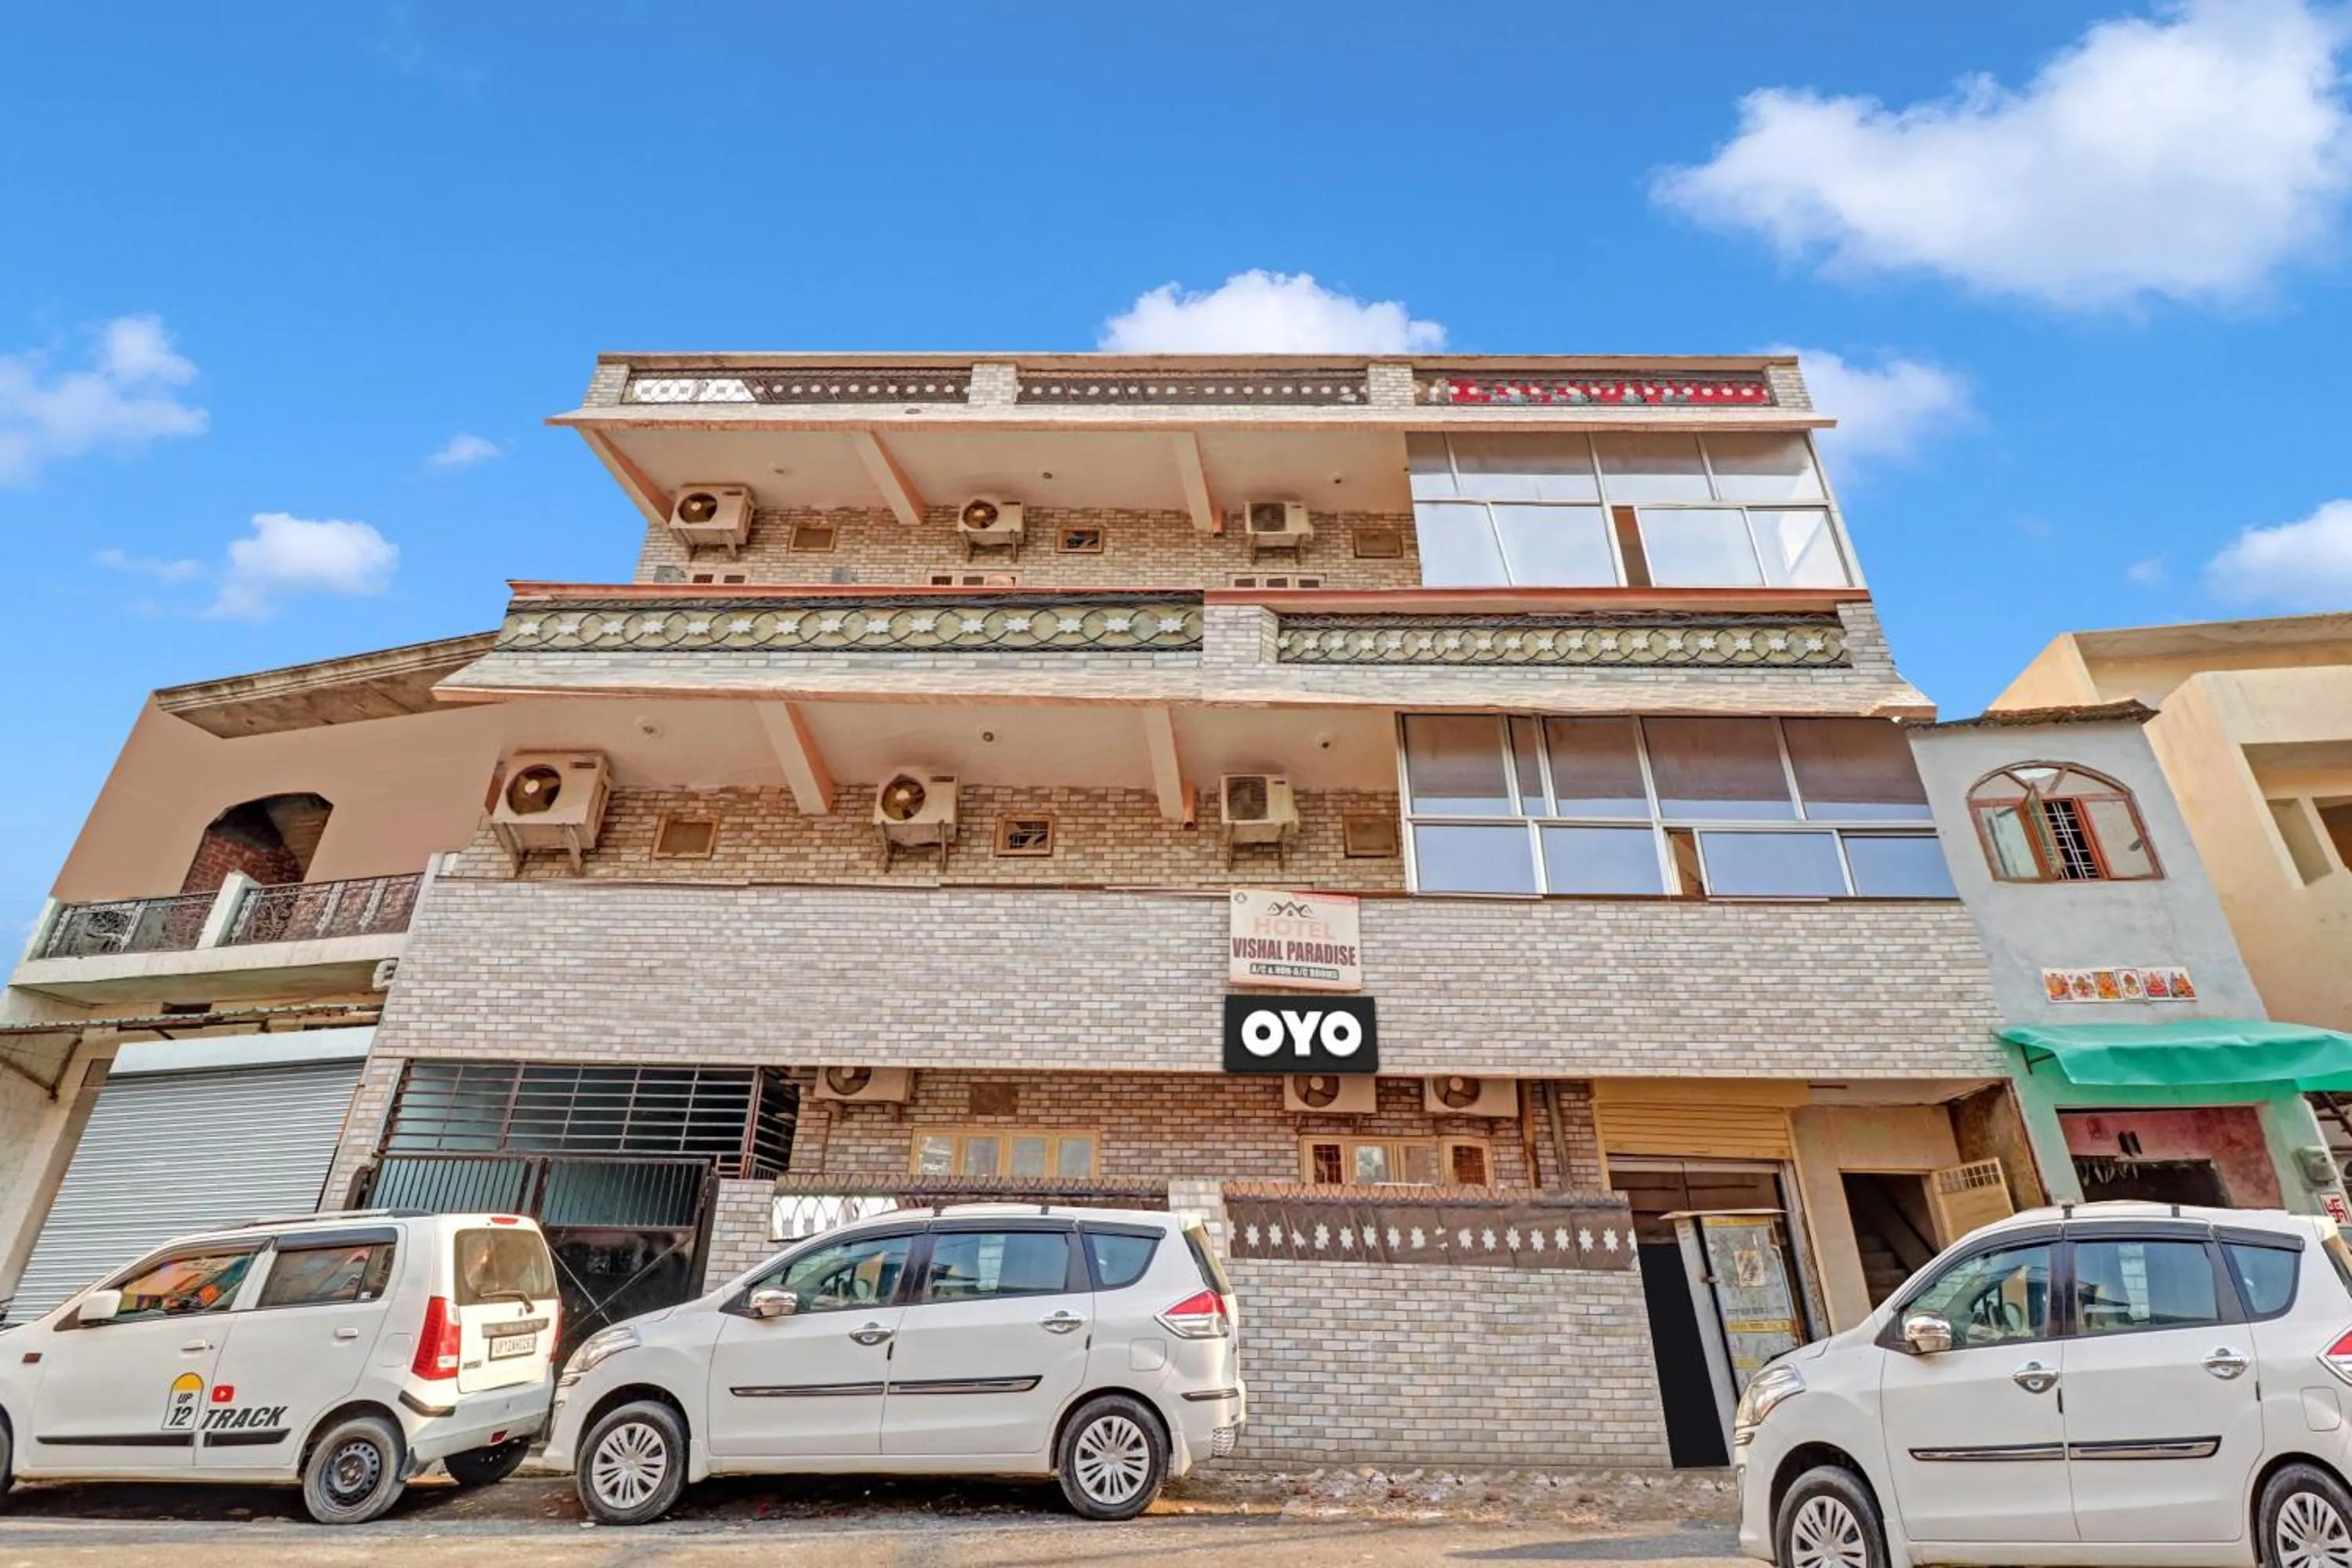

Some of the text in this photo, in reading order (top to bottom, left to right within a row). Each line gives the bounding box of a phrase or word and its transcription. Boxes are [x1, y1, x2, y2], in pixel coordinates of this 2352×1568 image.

[1254, 917, 1337, 939] HOTEL
[1232, 937, 1356, 966] VISHAL PARADISE
[1241, 1010, 1363, 1058] OYO
[177, 1392, 194, 1403] UP
[169, 1406, 194, 1426] 12
[201, 1406, 289, 1429] TRACK
